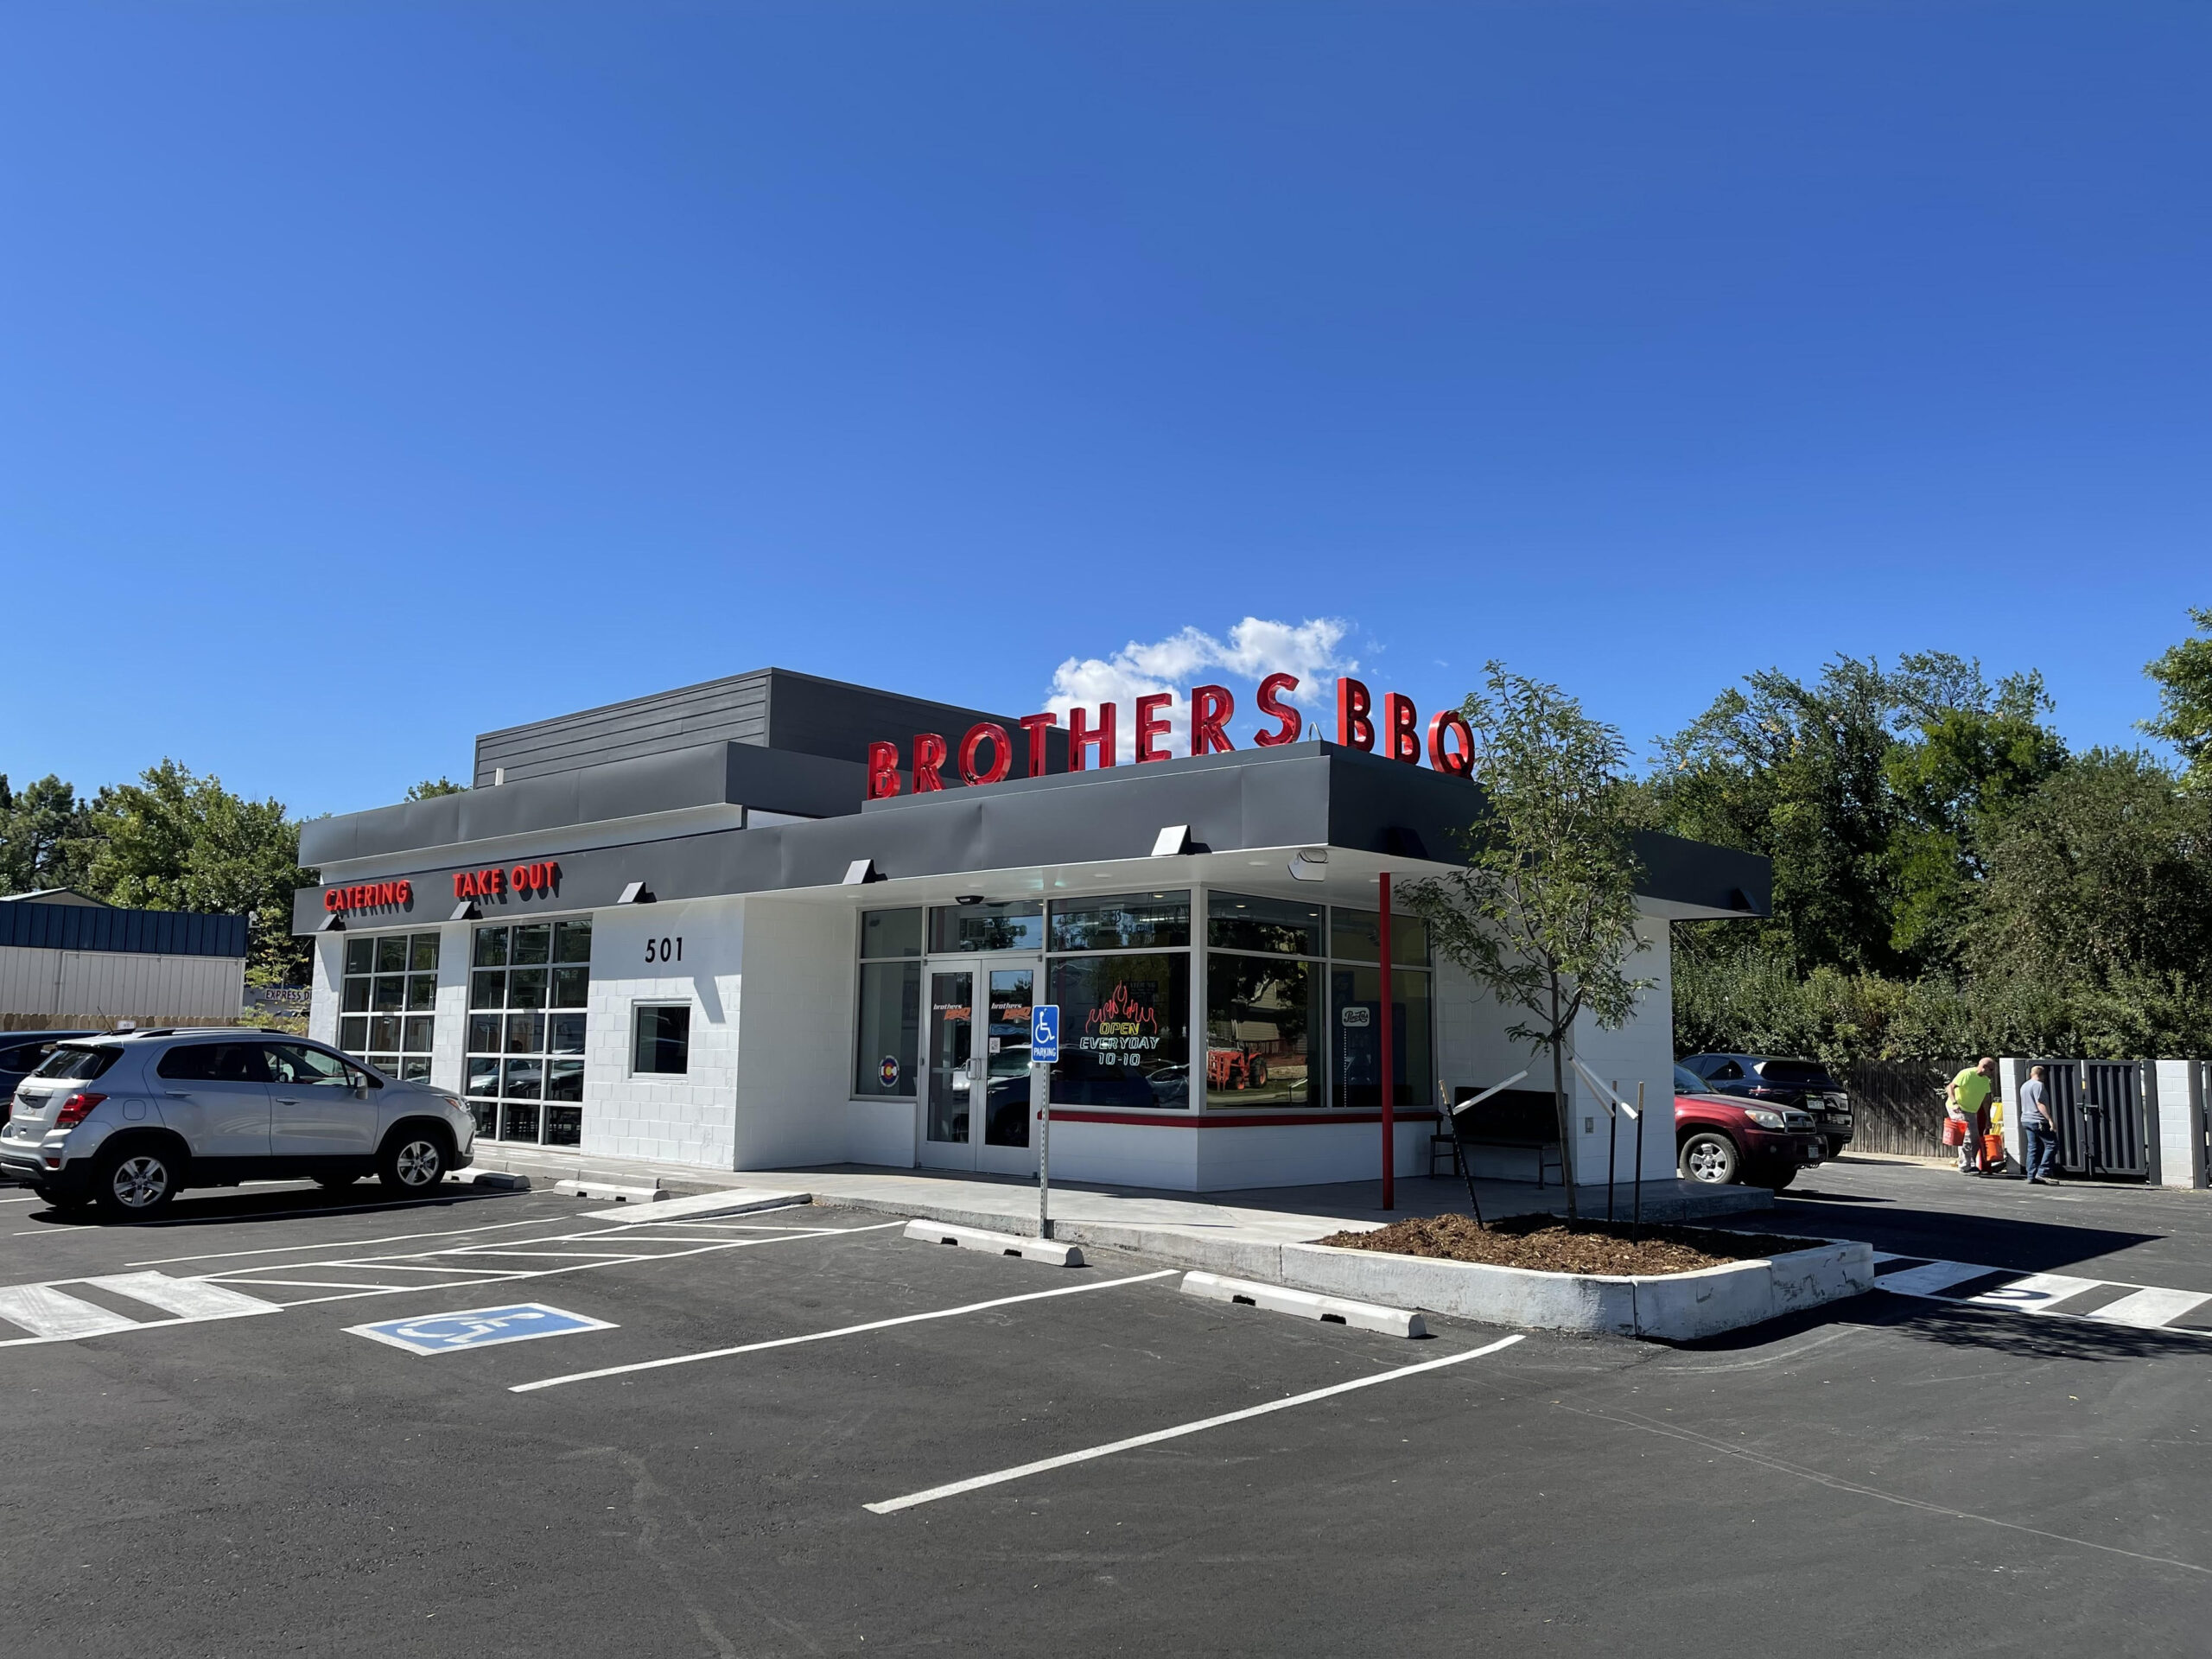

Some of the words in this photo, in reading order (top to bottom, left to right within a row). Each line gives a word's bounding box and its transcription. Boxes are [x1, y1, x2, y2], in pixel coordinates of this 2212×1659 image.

[868, 672, 1301, 800] BROTHERS
[1338, 677, 1476, 781] BBQ
[452, 868, 504, 898] TAKE
[511, 861, 556, 892] OUT
[324, 879, 412, 912] CATERING
[645, 937, 683, 963] 501
[265, 989, 302, 1001] EXPRESS
[303, 989, 312, 1001] D
[1099, 1022, 1141, 1035] OPEN
[1079, 1037, 1160, 1050] EVERYDAY
[1033, 1047, 1057, 1058] PARKING
[1098, 1052, 1141, 1066] 10-10
